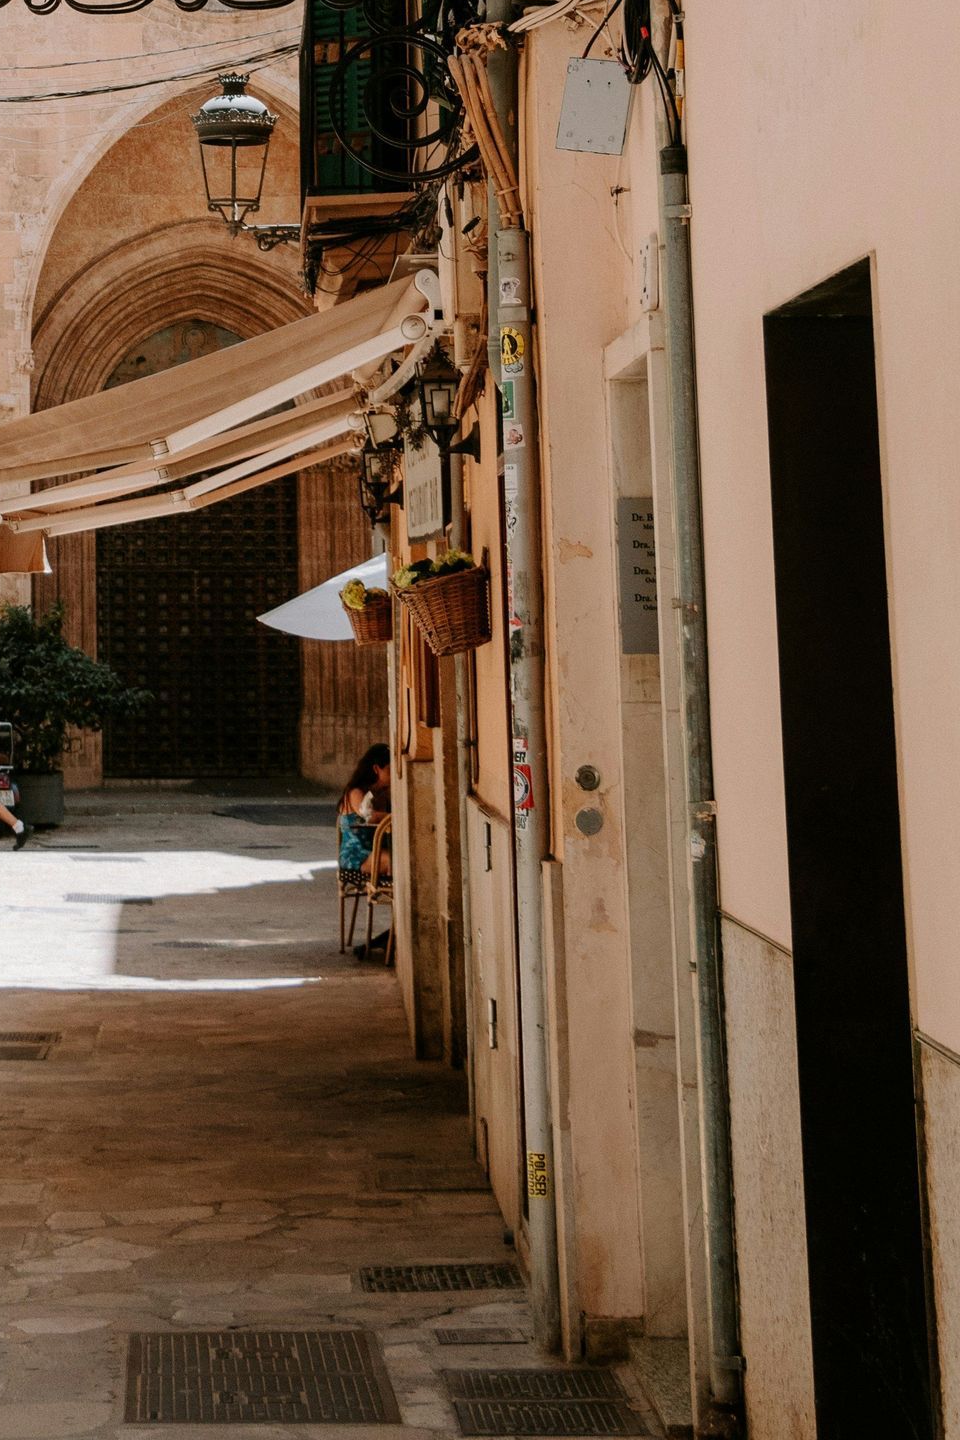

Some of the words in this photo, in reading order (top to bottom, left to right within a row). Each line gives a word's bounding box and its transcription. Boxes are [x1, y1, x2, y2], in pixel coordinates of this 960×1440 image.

[631, 513, 644, 522] Dr.
[633, 540, 650, 549] Dra.
[634, 566, 651, 575] Dra.
[533, 1153, 546, 1196] POLSER
